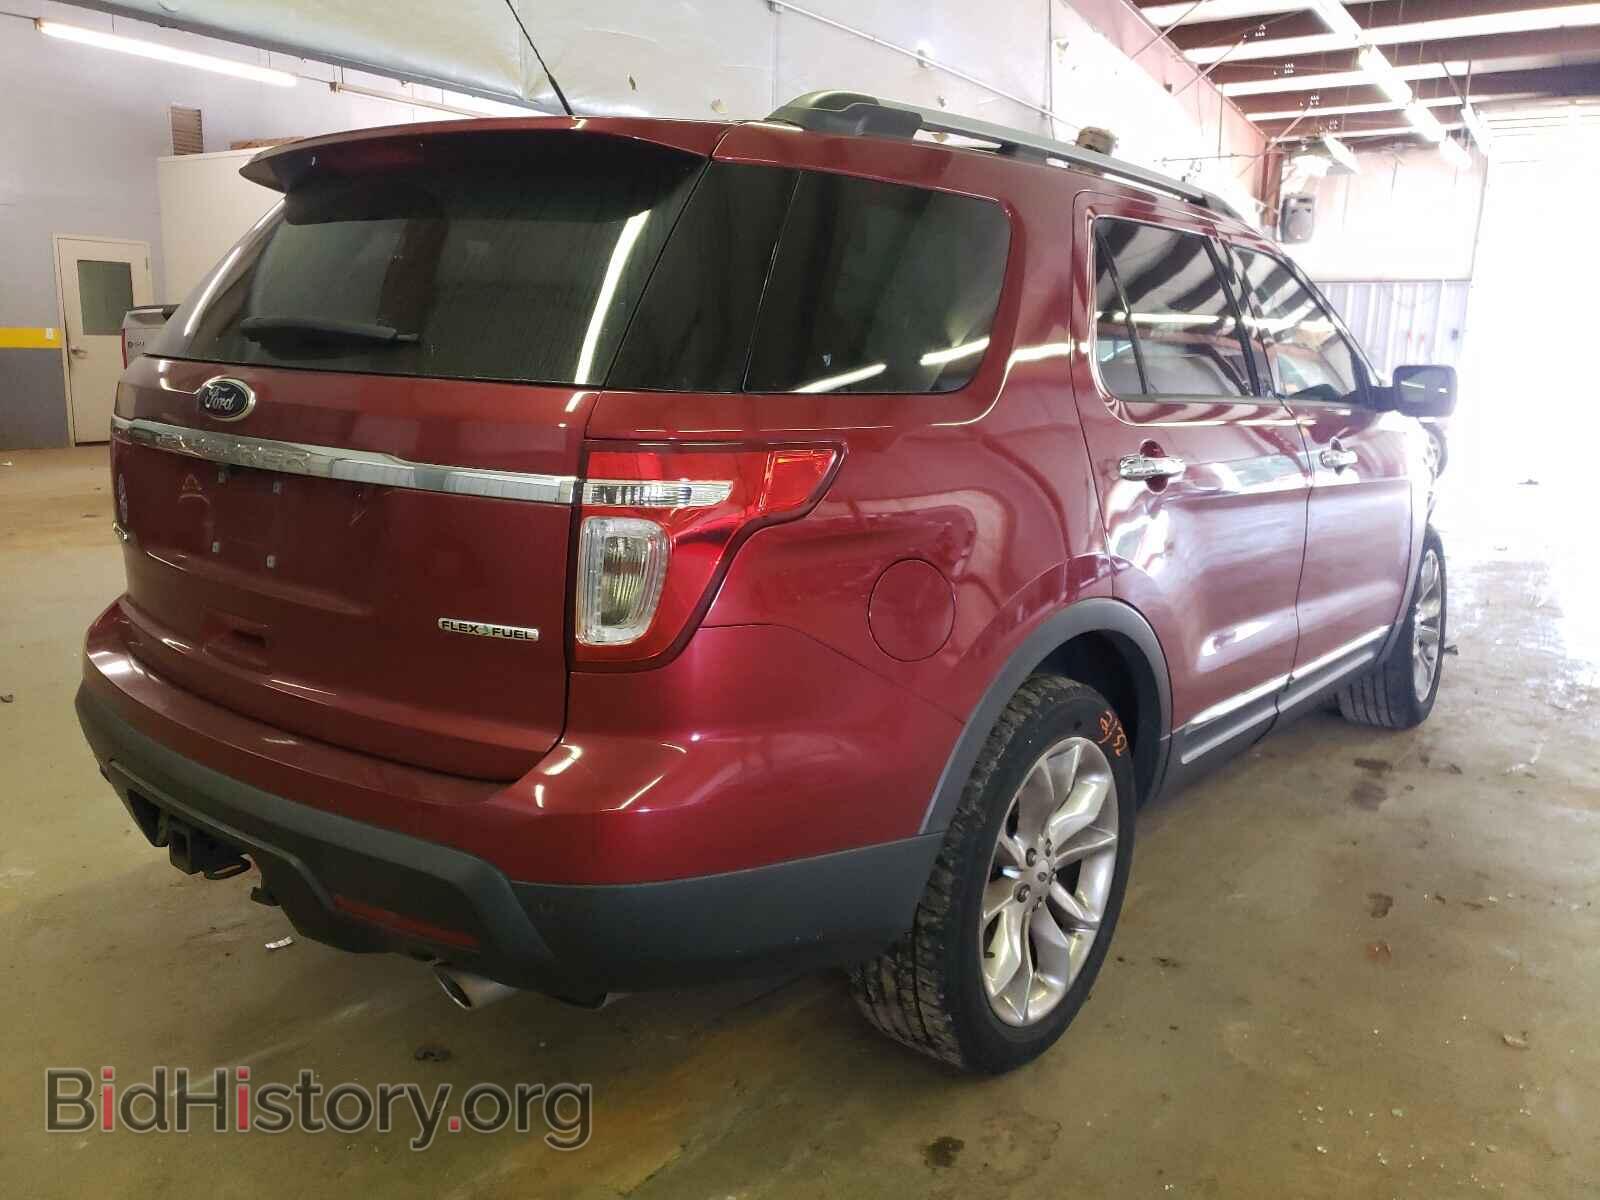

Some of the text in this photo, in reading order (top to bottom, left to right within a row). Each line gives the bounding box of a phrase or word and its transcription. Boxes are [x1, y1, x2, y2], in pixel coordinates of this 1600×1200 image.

[204, 385, 237, 410] Ford
[441, 620, 537, 640] FLEX FUEL
